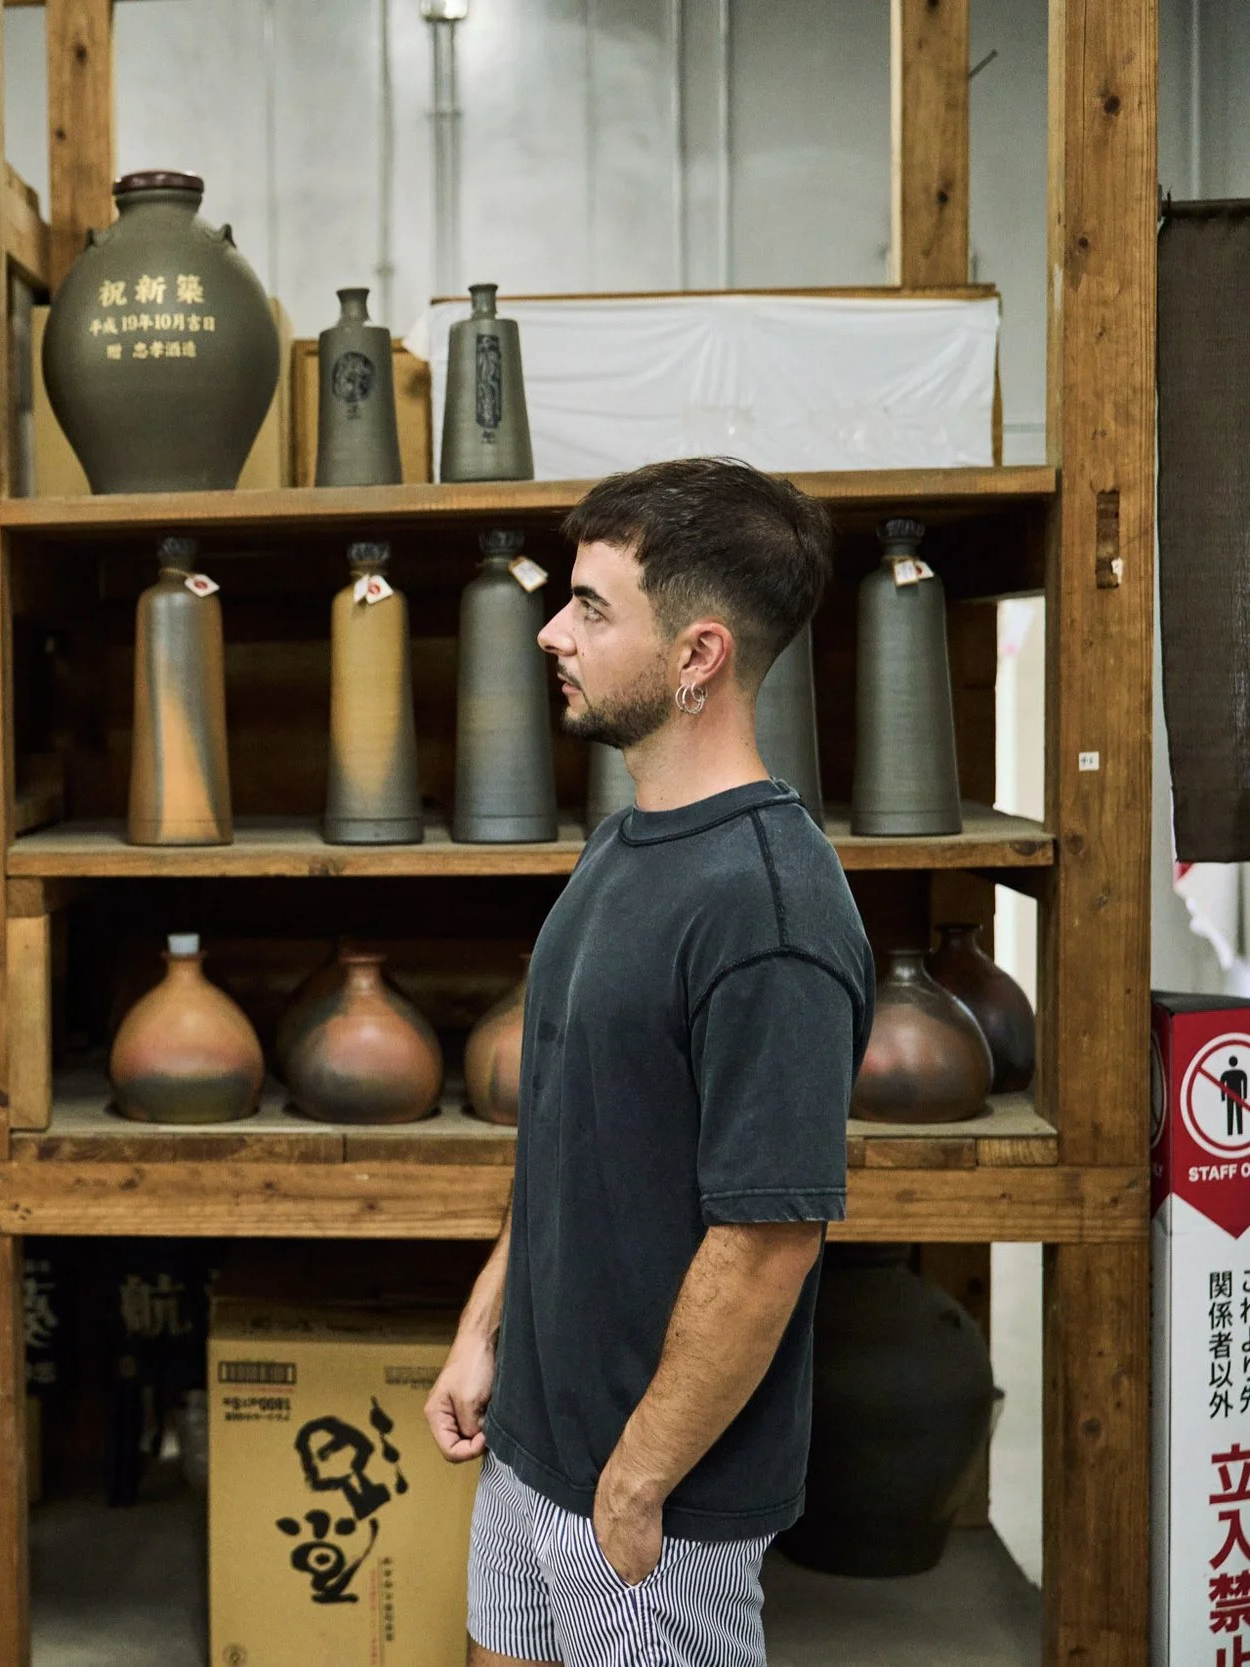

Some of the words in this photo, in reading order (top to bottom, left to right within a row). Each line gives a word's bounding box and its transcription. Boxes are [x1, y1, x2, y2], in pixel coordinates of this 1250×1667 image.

[98, 273, 205, 308] 祝新築
[1188, 1163, 1238, 1183] STAFF
[1208, 1270, 1233, 1419] 関係者以外
